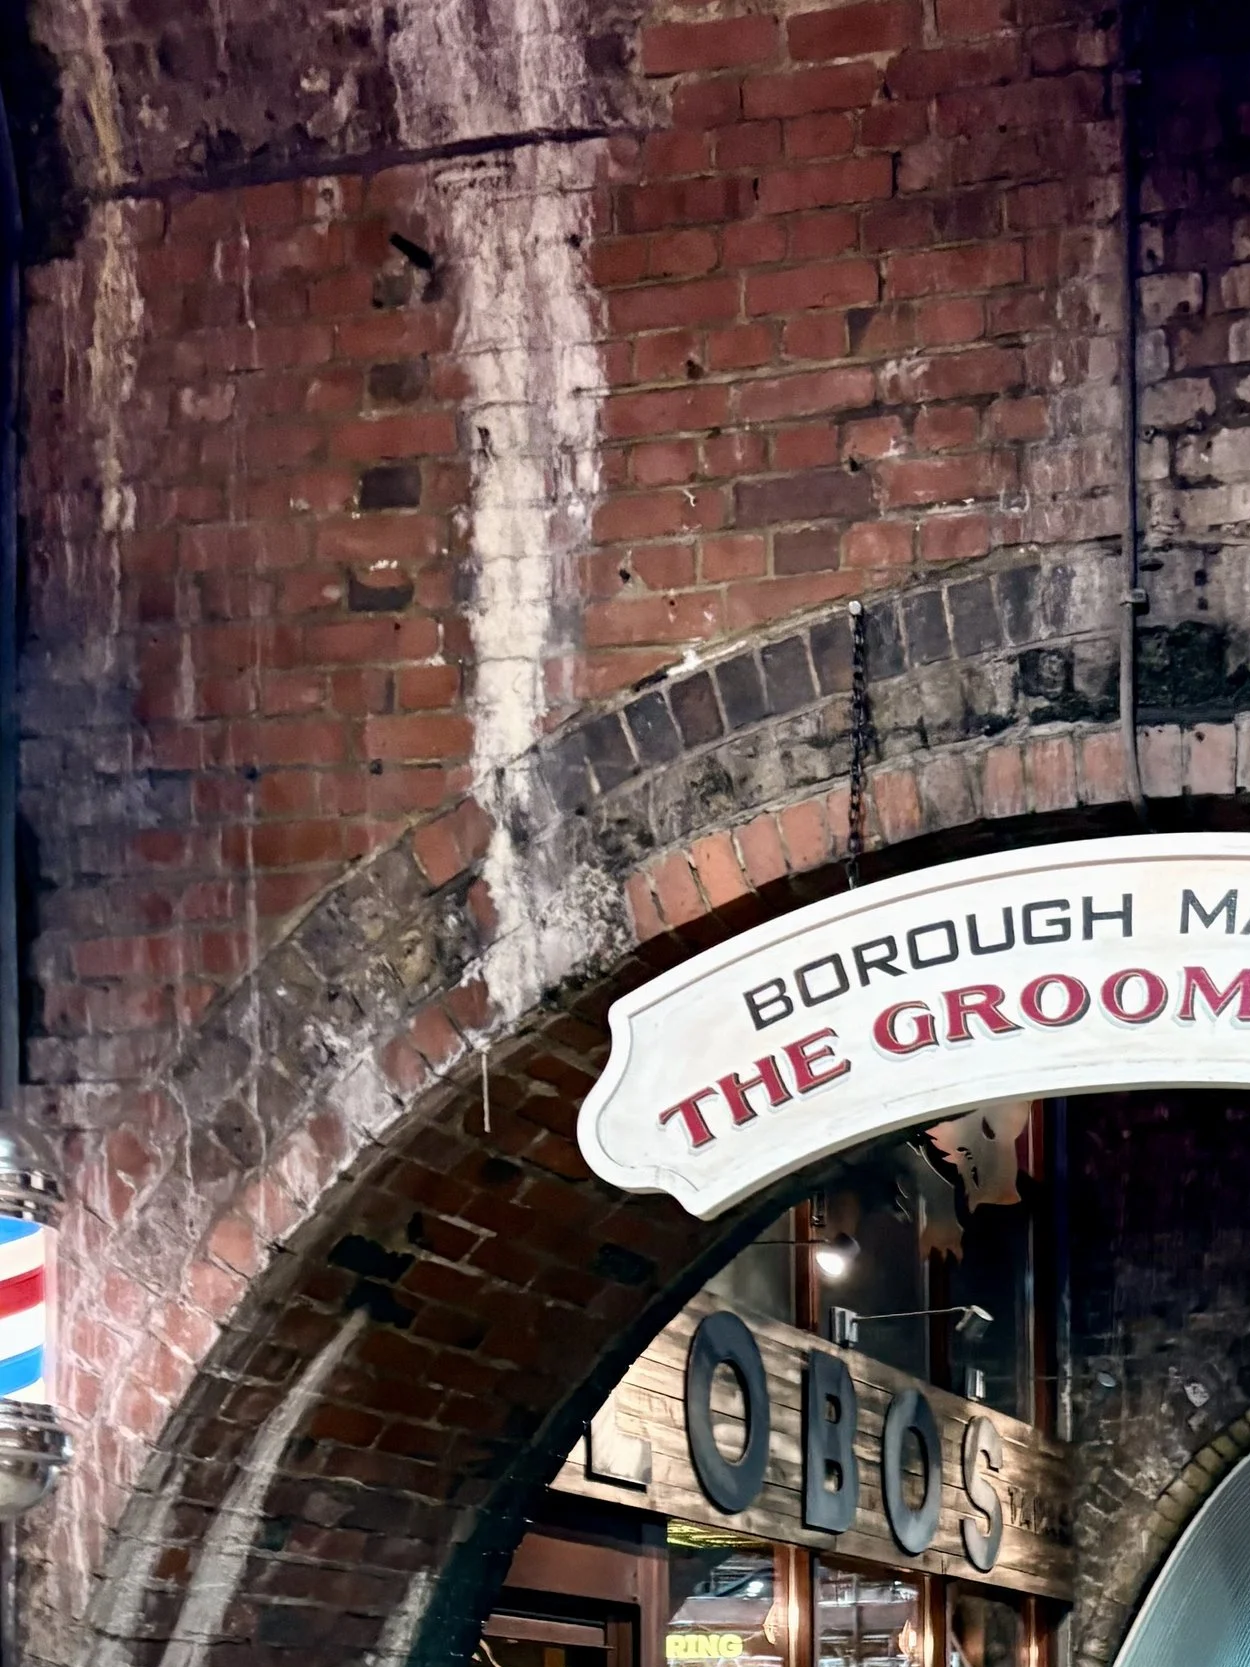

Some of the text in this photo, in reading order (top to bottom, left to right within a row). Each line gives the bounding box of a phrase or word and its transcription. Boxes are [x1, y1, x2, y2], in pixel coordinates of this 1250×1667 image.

[743, 892, 1133, 1030] BOROUGH
[658, 1027, 852, 1149] THE
[665, 1633, 743, 1659] RING
